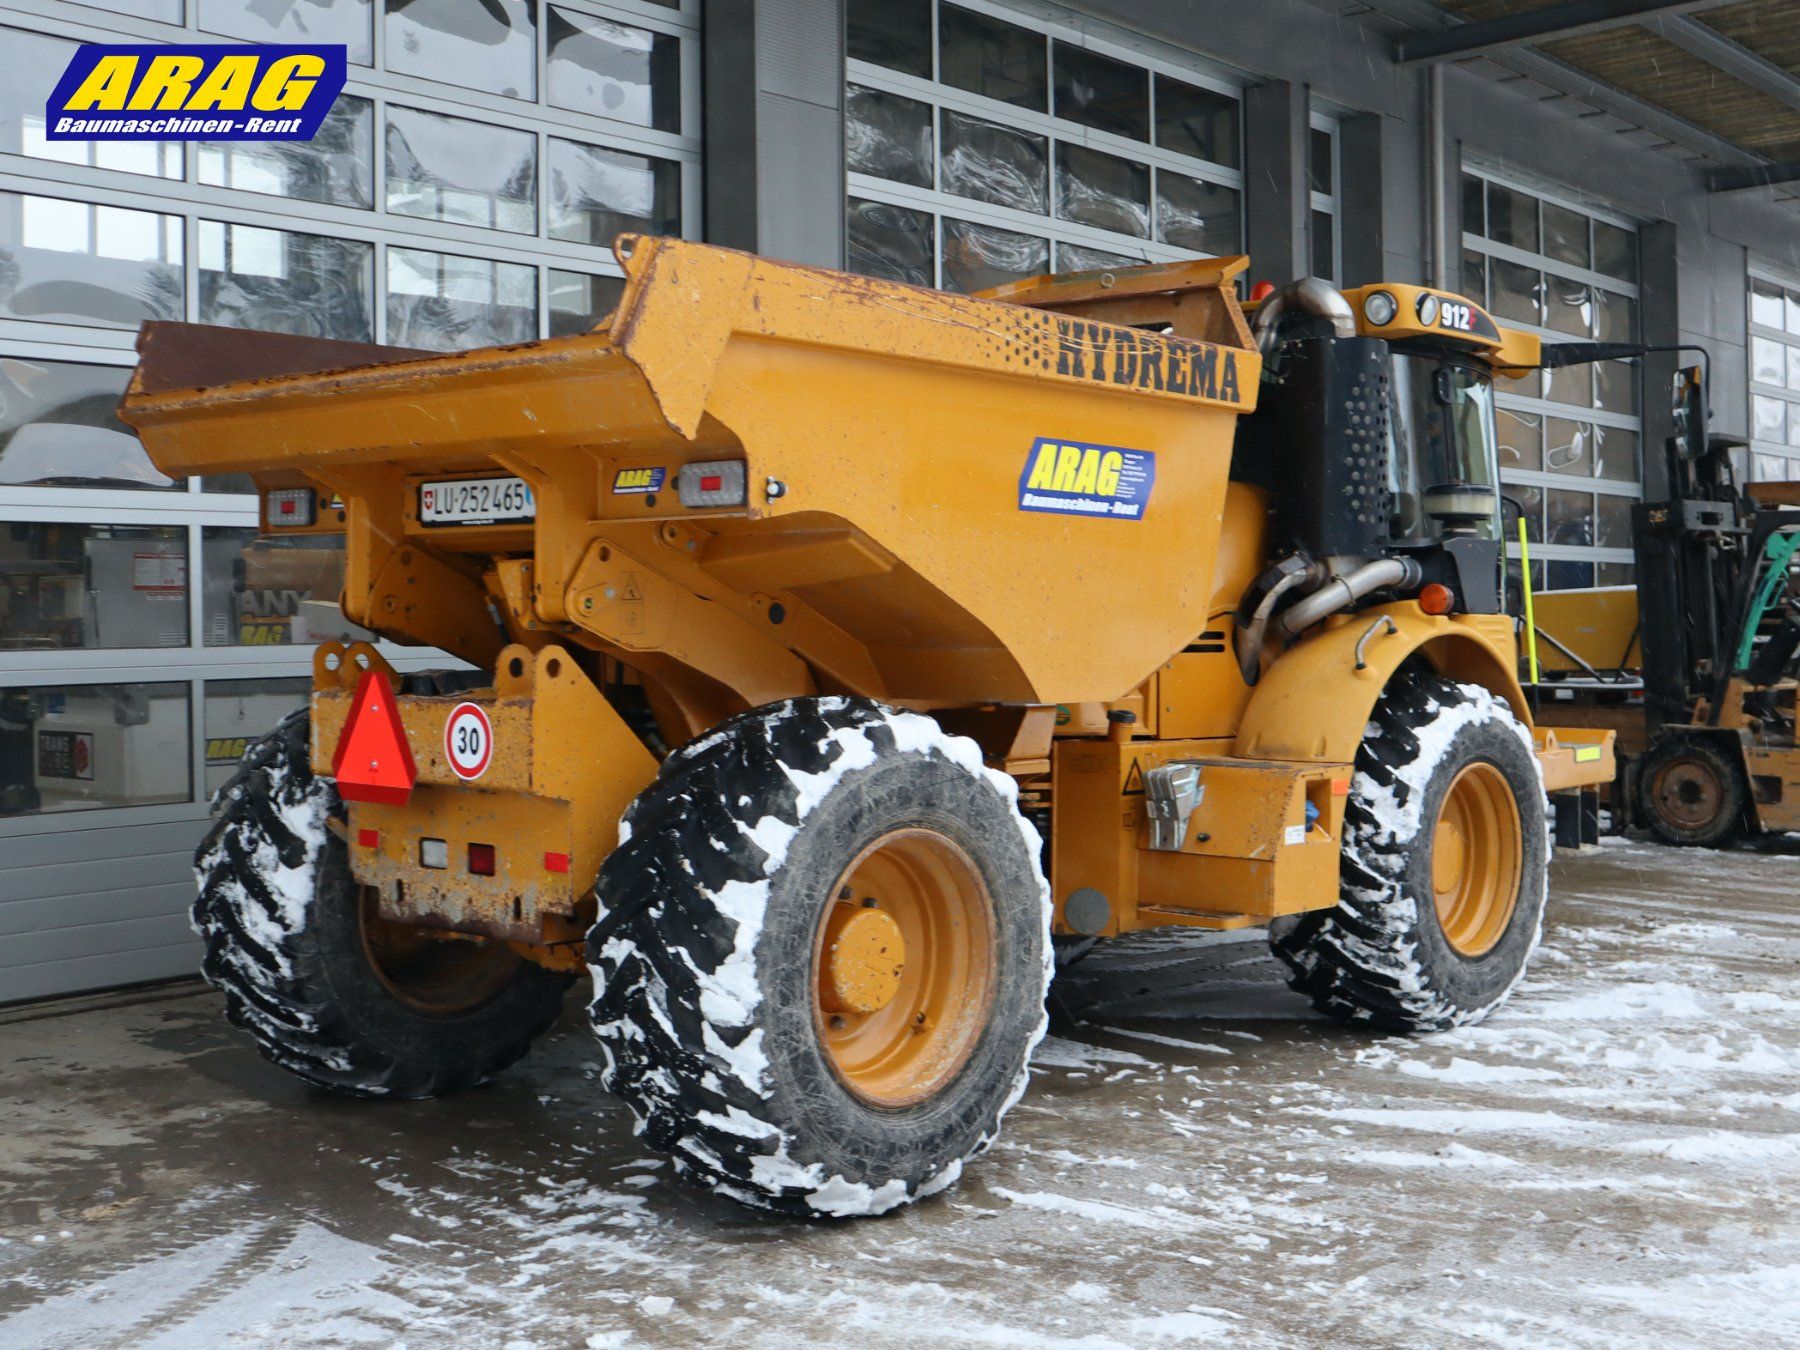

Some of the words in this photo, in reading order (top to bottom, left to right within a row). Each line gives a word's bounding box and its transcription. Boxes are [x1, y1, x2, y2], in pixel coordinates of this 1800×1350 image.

[1055, 317, 1241, 403] HYDREMA
[616, 469, 652, 487] ARAG
[1026, 443, 1123, 497] ARAG
[458, 726, 480, 755] 30
